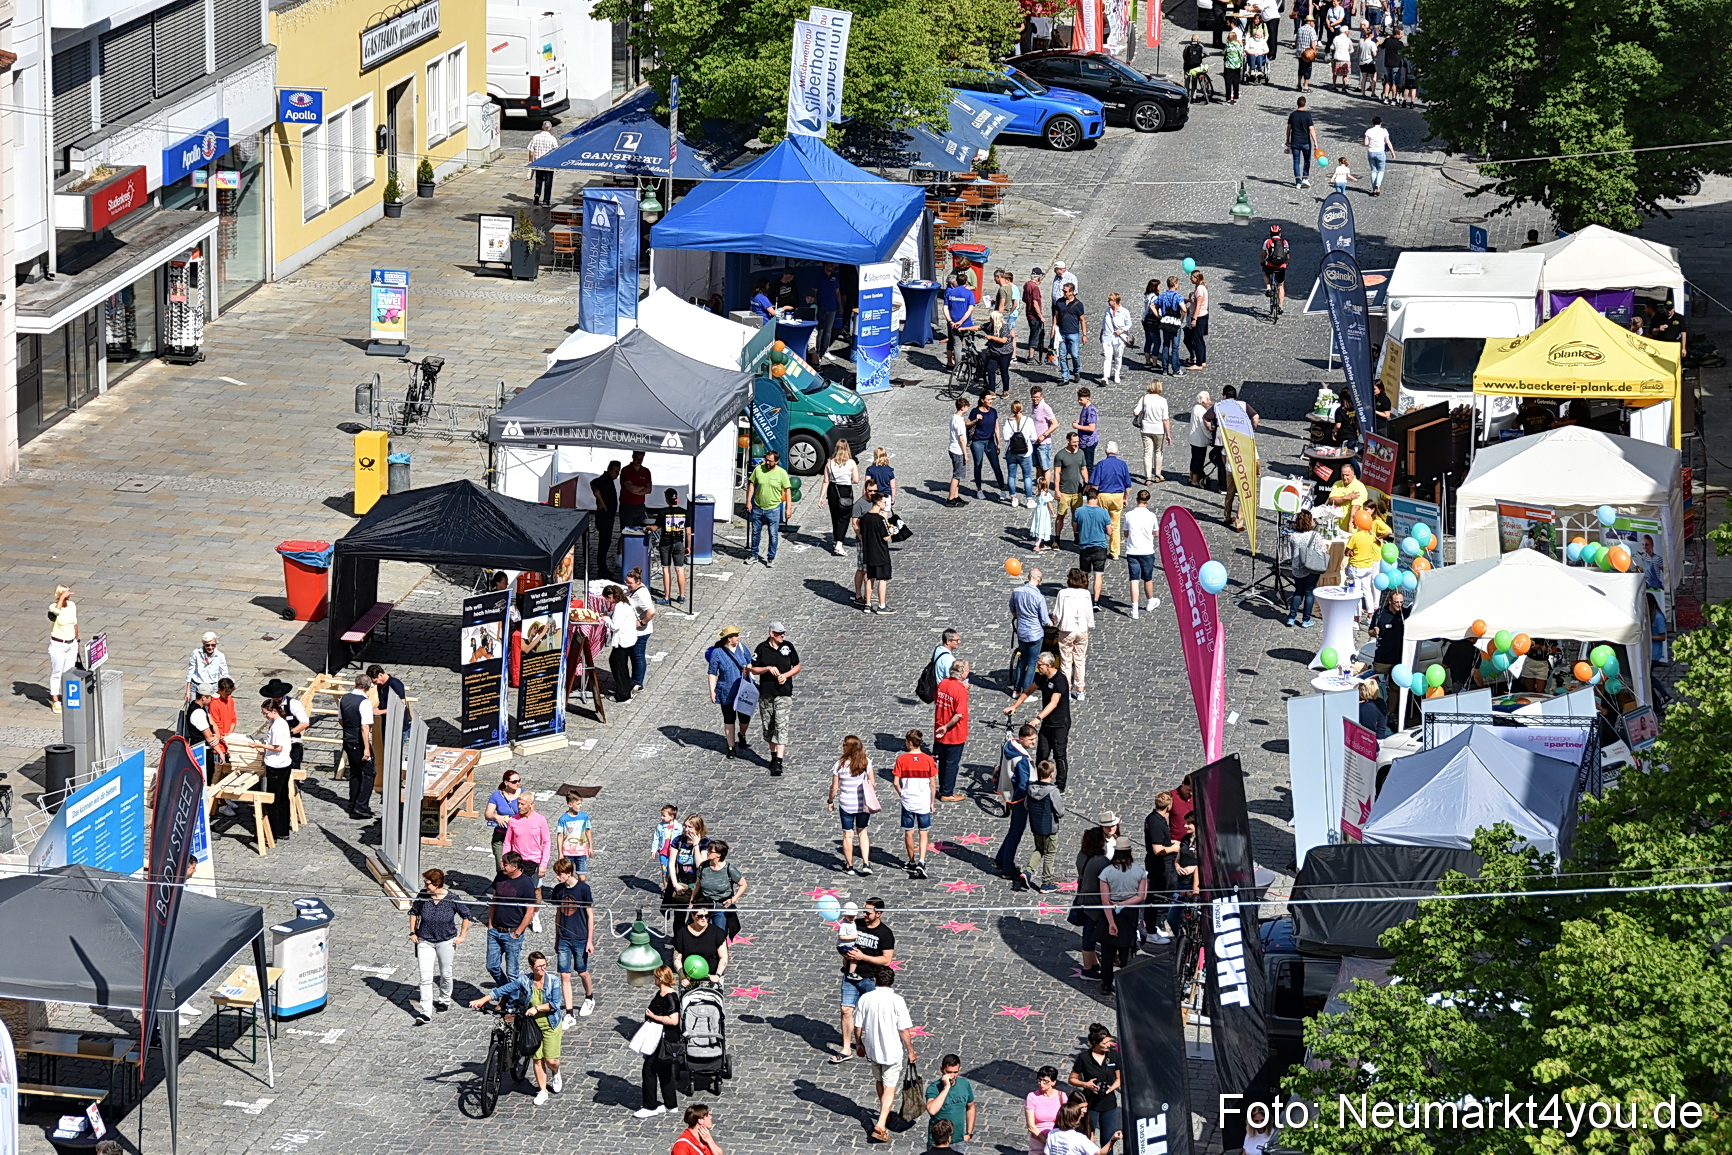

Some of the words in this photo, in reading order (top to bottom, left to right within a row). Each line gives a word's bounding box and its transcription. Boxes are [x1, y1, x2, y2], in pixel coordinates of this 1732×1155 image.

[365, 25, 398, 59] GASTHAUS
[421, 5, 437, 30] GANS
[805, 30, 827, 115] Silberhorn
[285, 110, 317, 121] Apollo
[182, 145, 201, 170] Apollo
[581, 151, 663, 165] GANSBRÄU
[1553, 350, 1586, 360] plank
[1483, 380, 1633, 393] www.baeckerei-plank.de
[604, 430, 653, 444] NEUMARKT
[69, 684, 78, 697] P
[80, 801, 93, 814] können
[156, 848, 177, 919] BODY
[171, 775, 194, 853] STREET
